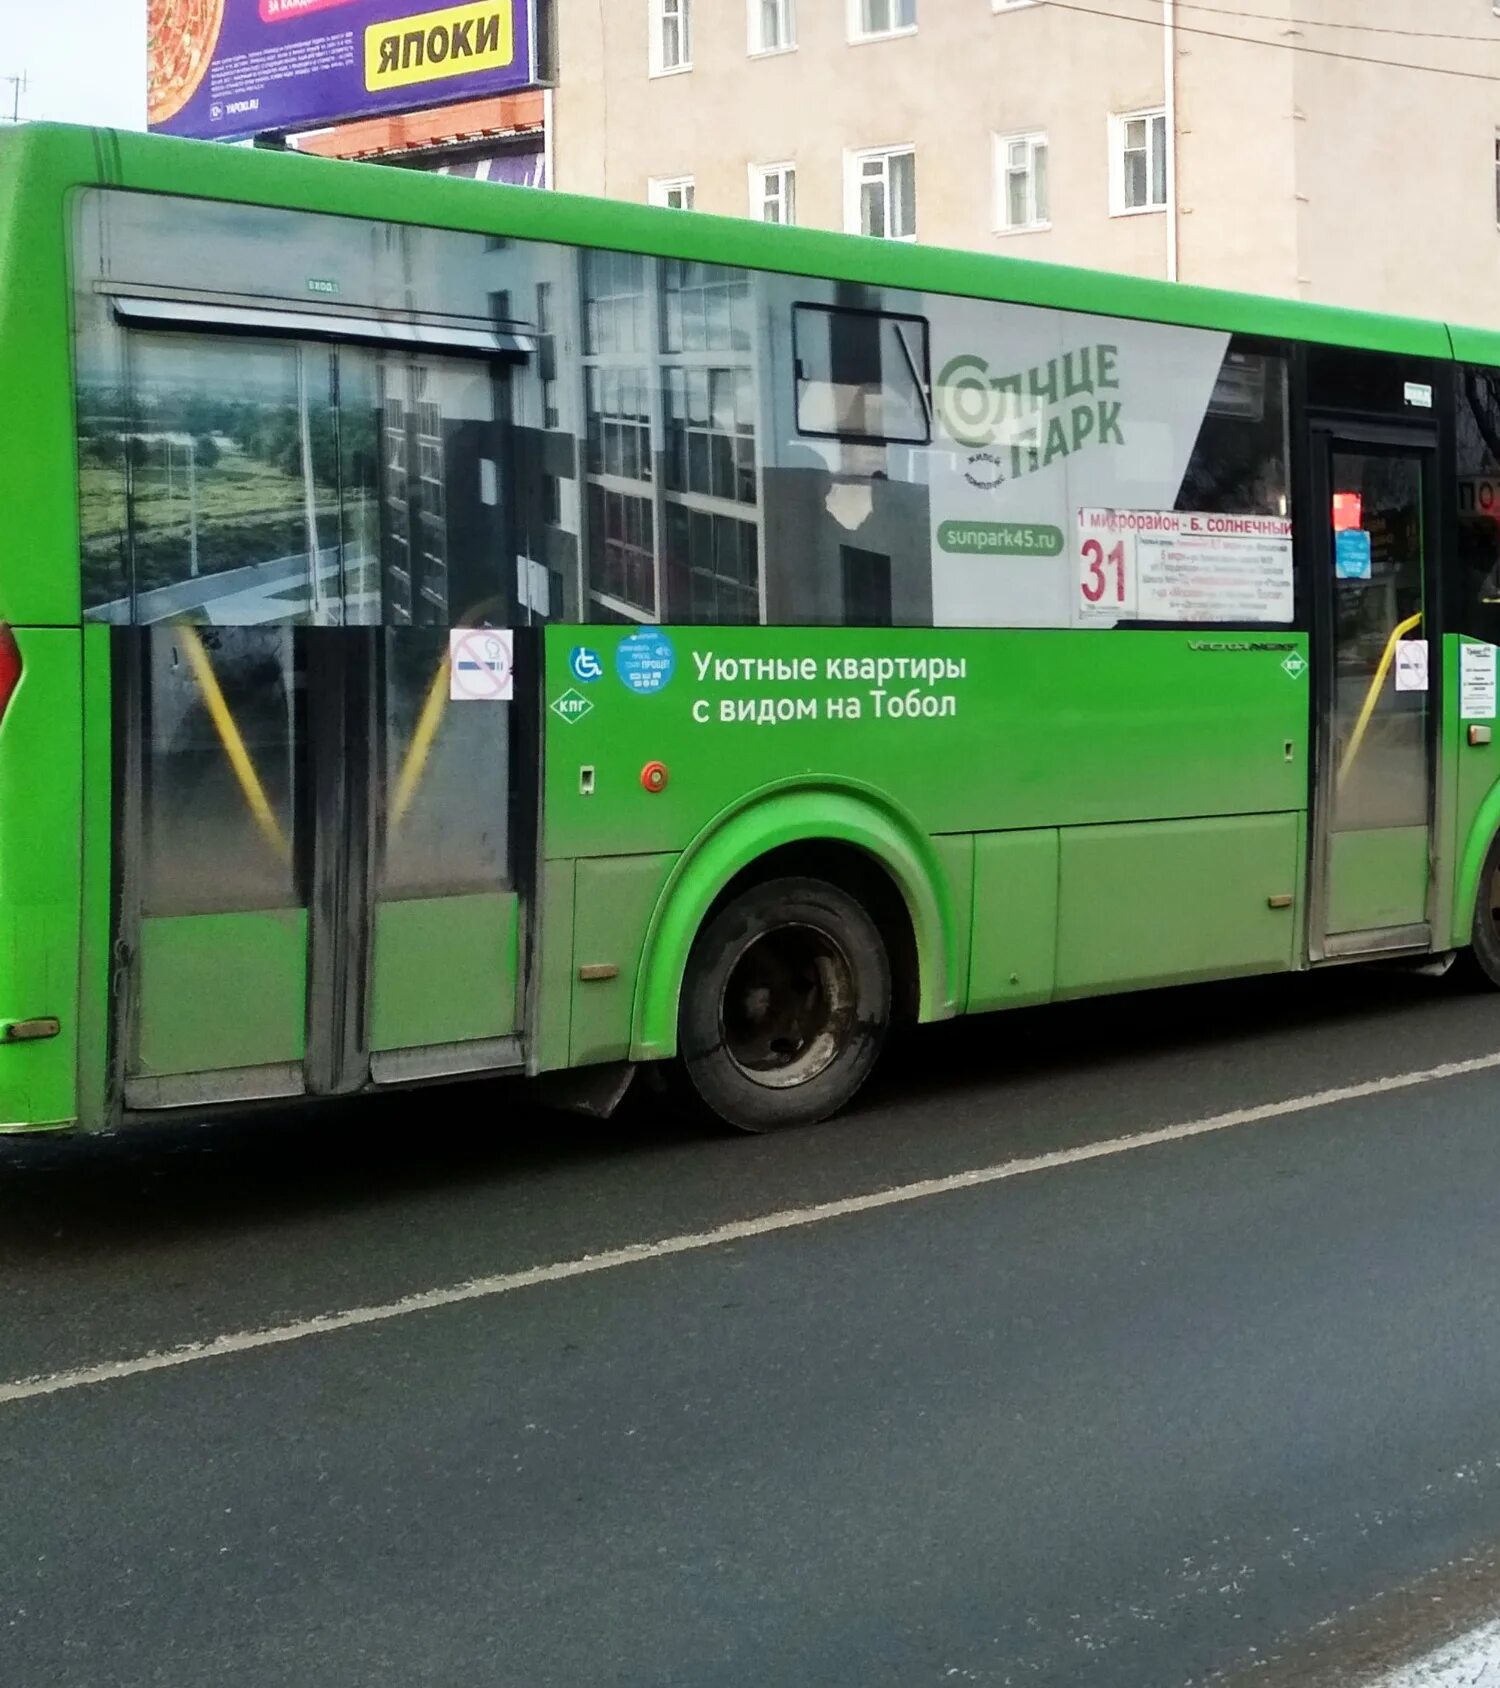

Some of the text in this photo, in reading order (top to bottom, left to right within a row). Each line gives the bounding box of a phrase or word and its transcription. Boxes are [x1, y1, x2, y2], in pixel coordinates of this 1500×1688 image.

[377, 14, 500, 74] ЯПОКИ
[1010, 400, 1126, 479] ПАРК
[947, 527, 1055, 553] sunpark45.ru
[1190, 517, 1204, 531] Б.
[1080, 538, 1126, 603] 31
[692, 651, 967, 687] Уютные квартиры
[559, 700, 586, 713] КПГ
[692, 688, 957, 726] с видом на Тобол
